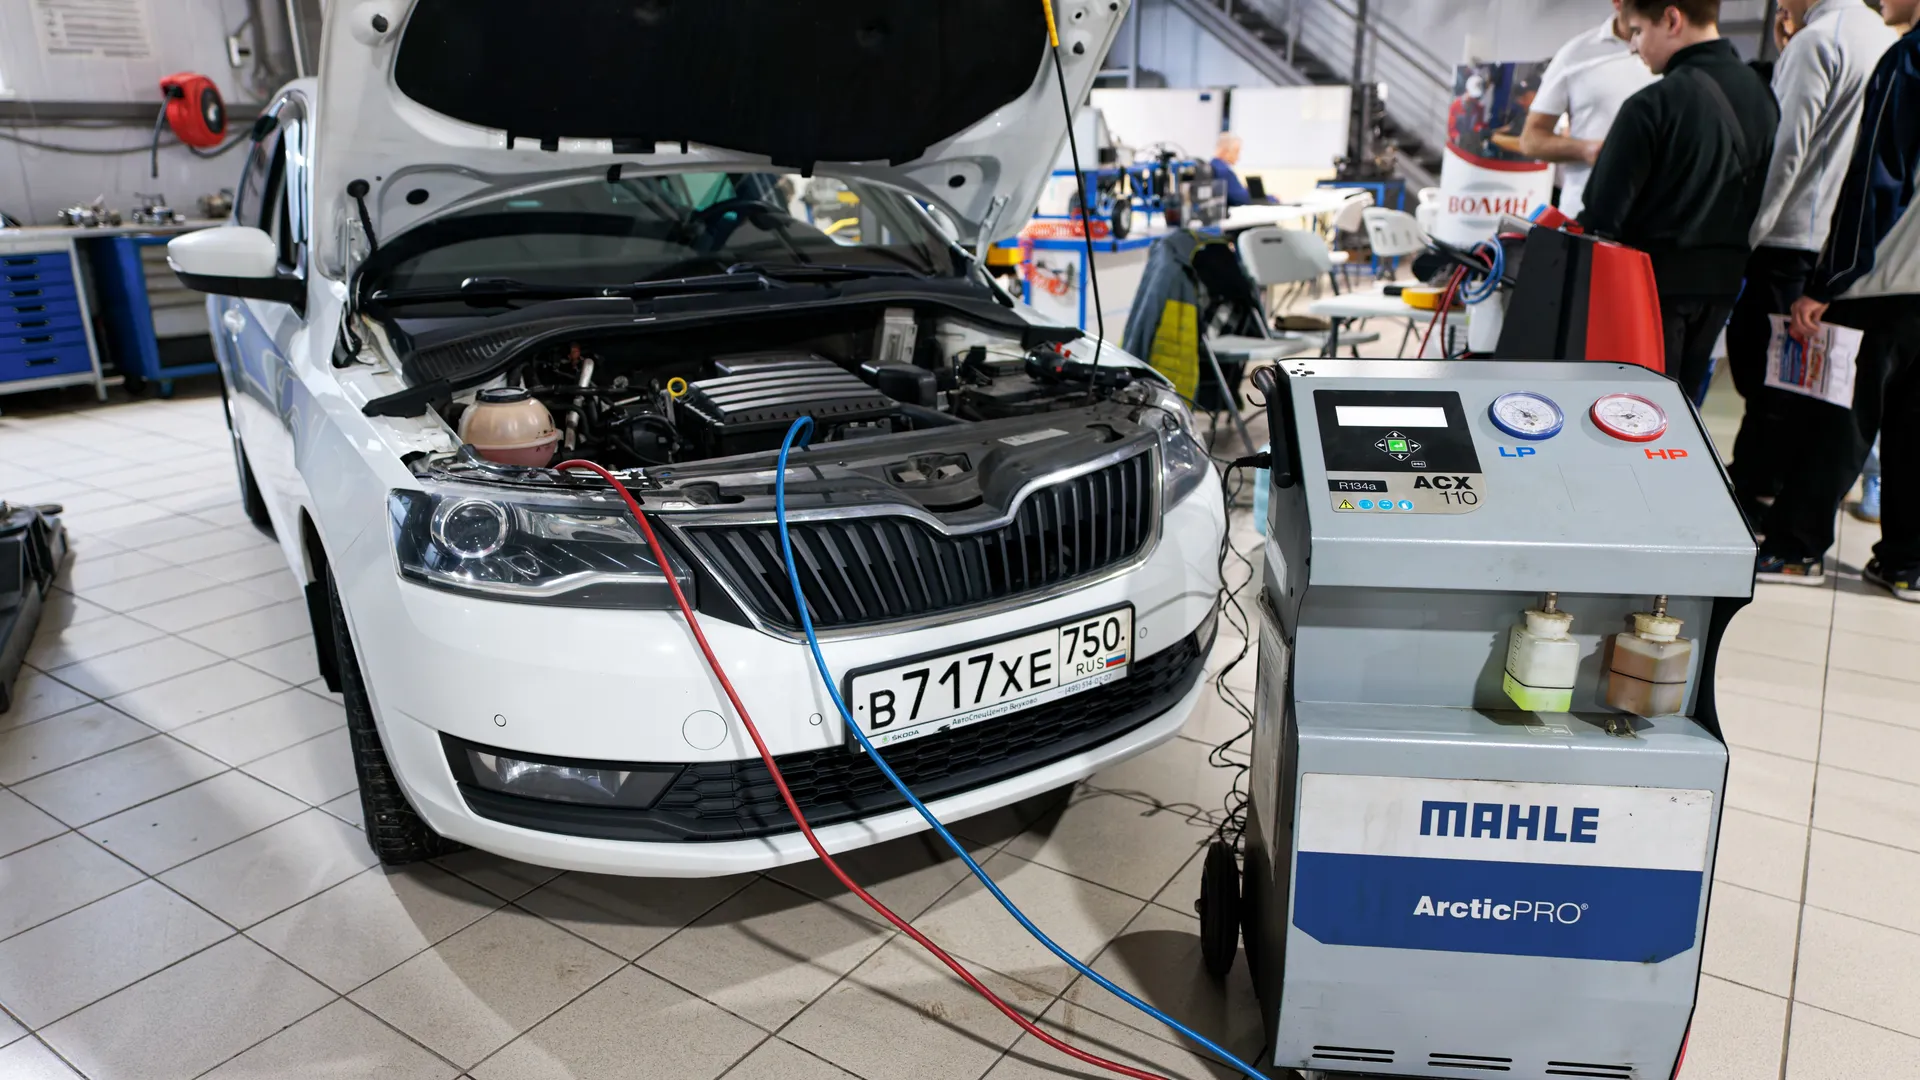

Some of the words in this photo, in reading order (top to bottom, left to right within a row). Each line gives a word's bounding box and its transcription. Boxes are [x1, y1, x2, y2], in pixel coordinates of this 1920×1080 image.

[1449, 196, 1528, 215] ВОЛИН
[1499, 446, 1536, 458] LP
[1644, 448, 1688, 460] HP
[1338, 481, 1377, 490] R134a
[1413, 476, 1473, 489] ACX
[1439, 491, 1478, 505] 110
[1063, 617, 1120, 664] 750
[1076, 657, 1104, 676] RUS
[1419, 800, 1600, 844] MAHLE
